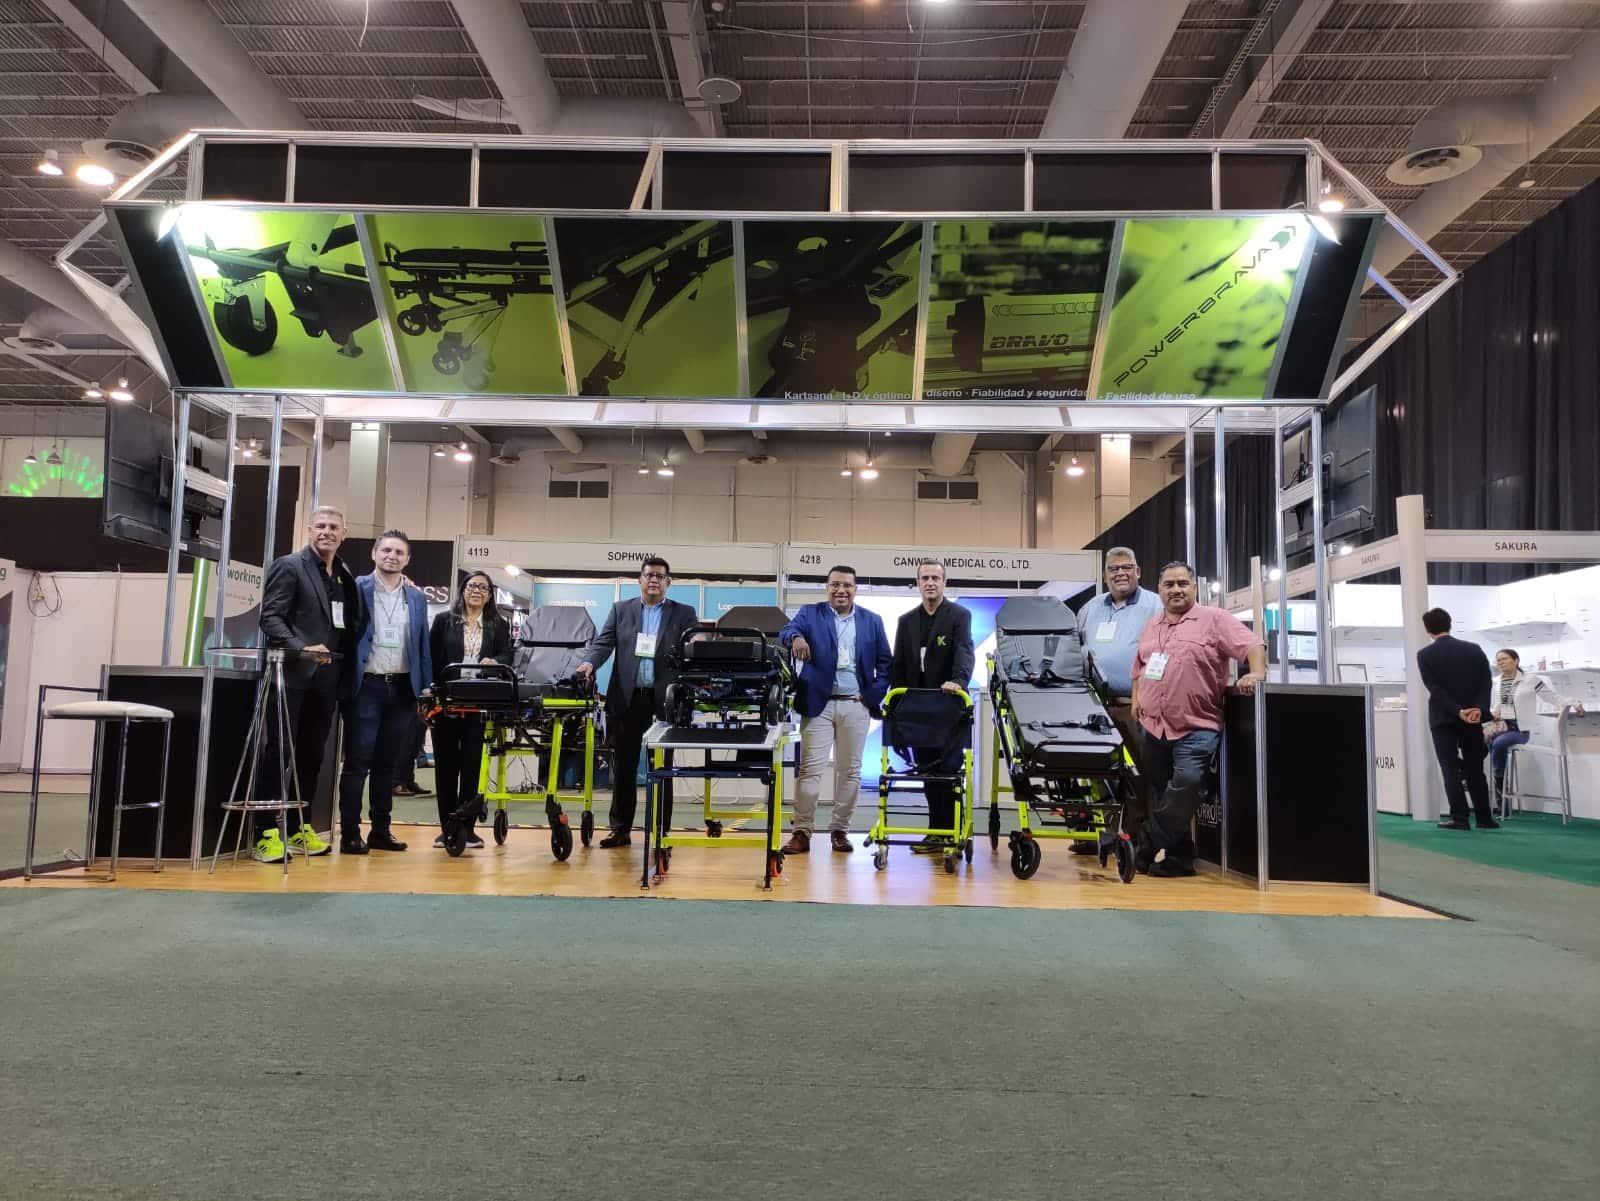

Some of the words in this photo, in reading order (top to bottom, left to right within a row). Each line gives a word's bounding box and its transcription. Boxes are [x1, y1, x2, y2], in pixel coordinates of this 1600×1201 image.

[1113, 248, 1272, 387] POWERBRAVA
[990, 333, 1070, 349] BRAVO
[784, 391, 833, 401] Kartsana
[971, 387, 1025, 398] Fiabilidad
[1026, 389, 1035, 399] y
[1106, 391, 1157, 401] Facilidad
[1159, 391, 1174, 401] de
[1176, 393, 1196, 401] uso
[467, 547, 489, 558] 4119
[1495, 541, 1538, 552] SAKURA
[799, 555, 822, 566] 4218
[893, 557, 941, 568] CANW
[943, 558, 987, 569] MEDICAL
[1011, 559, 1032, 570] LTD.
[936, 634, 948, 647] K
